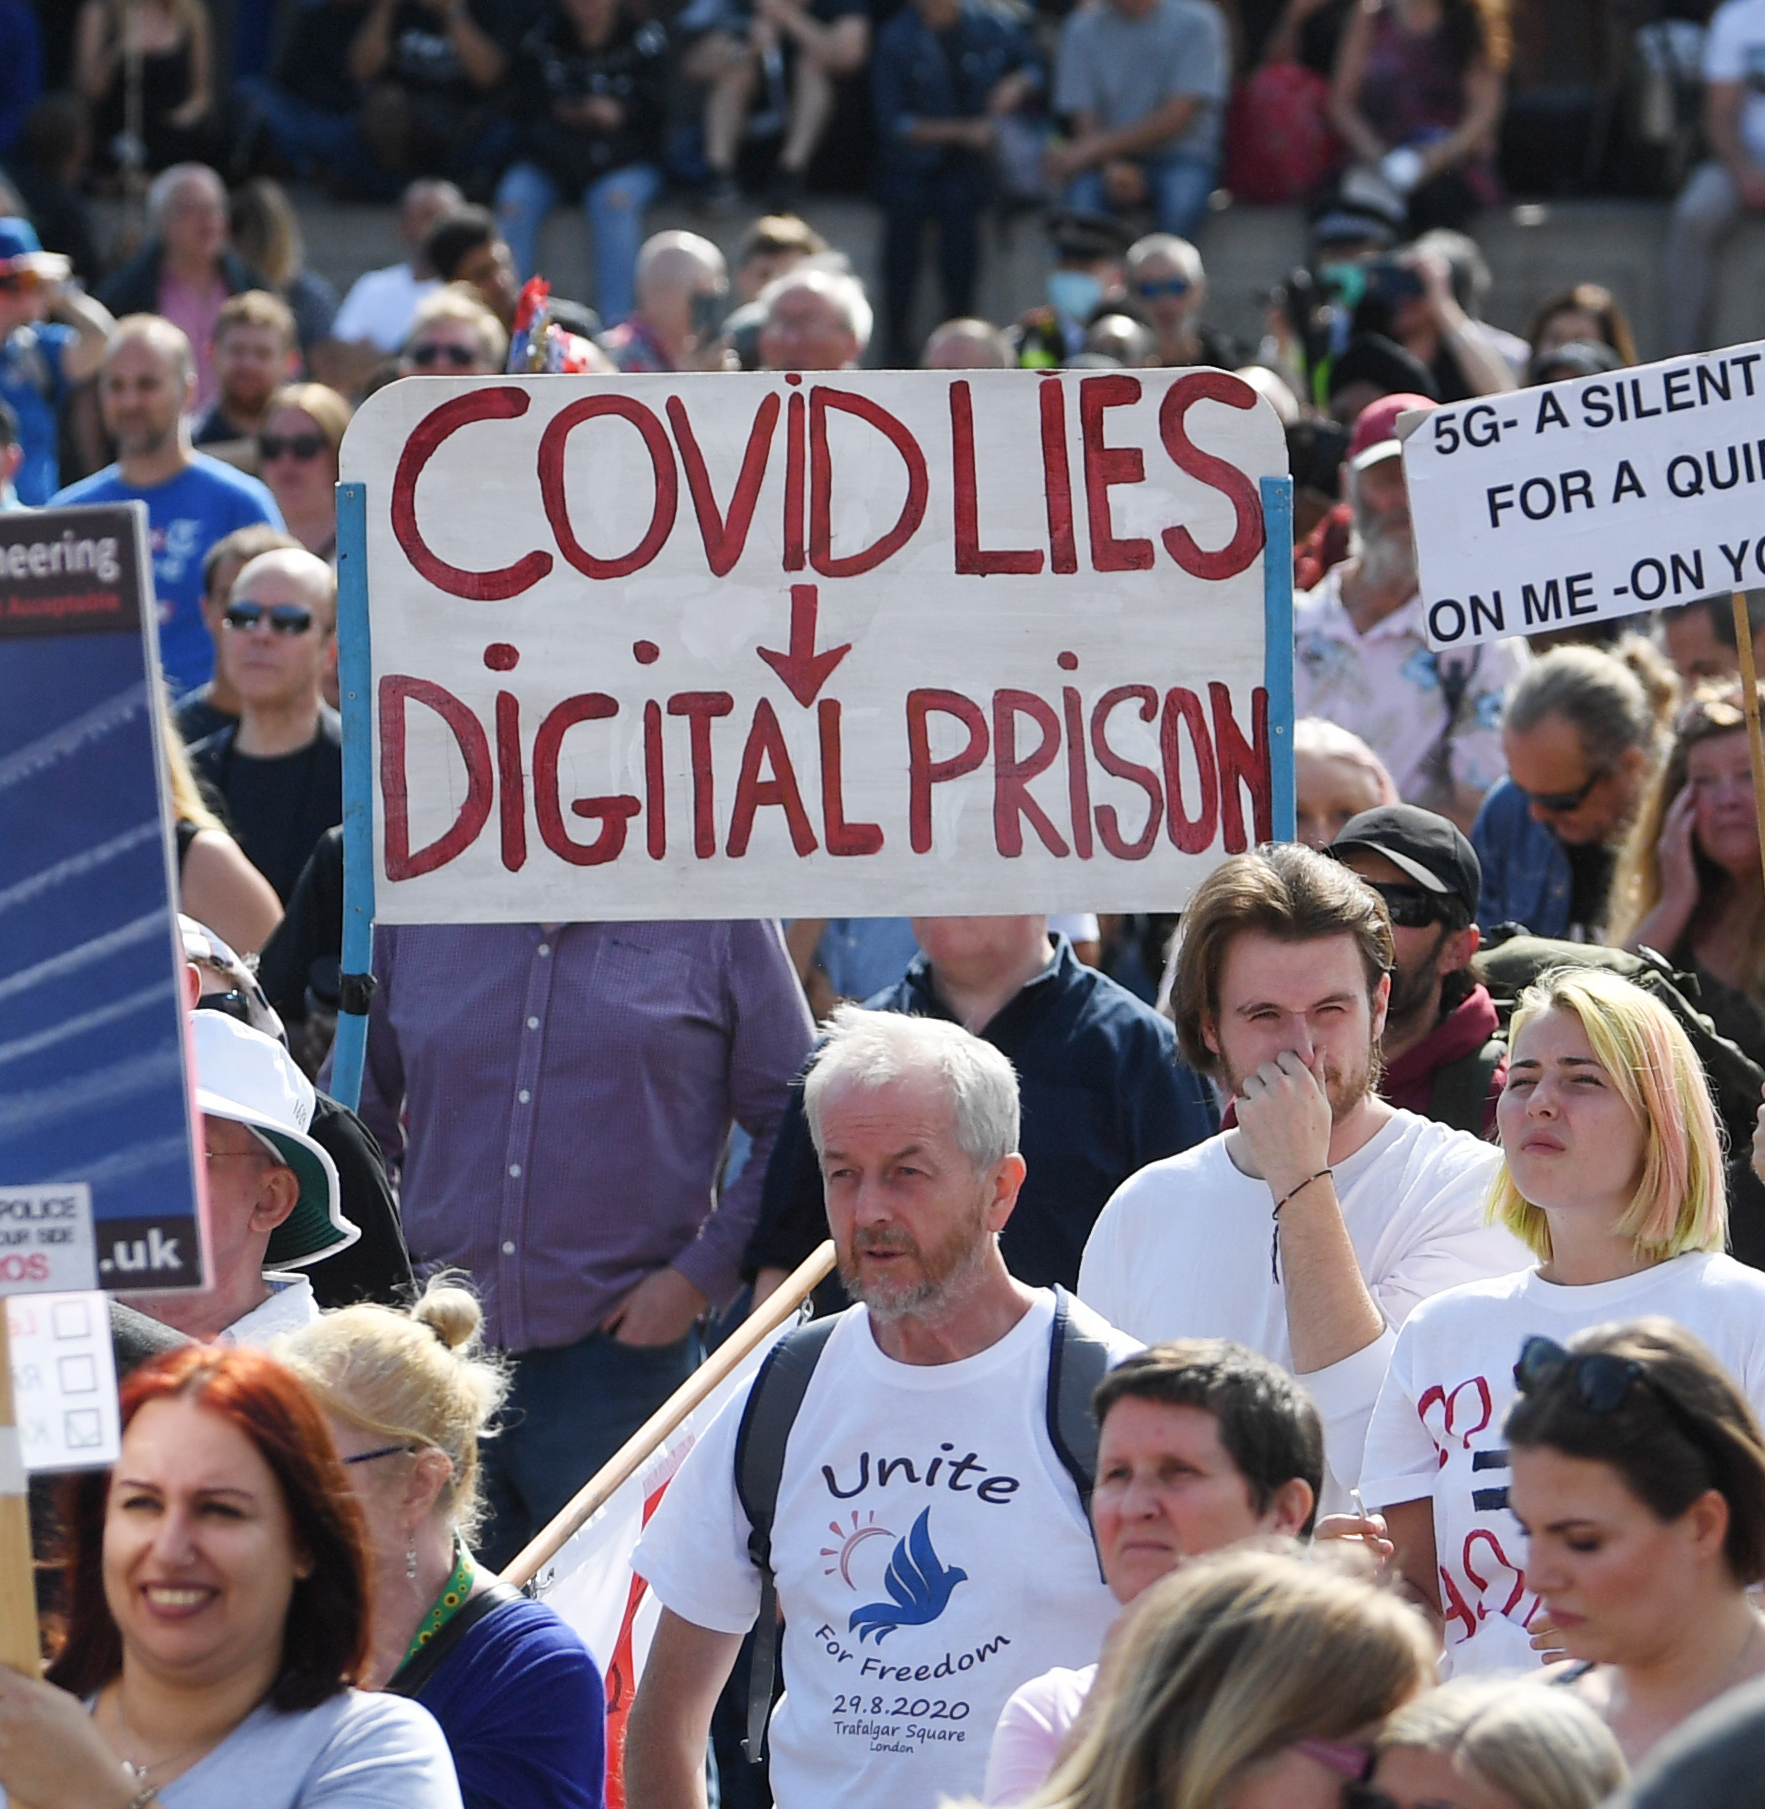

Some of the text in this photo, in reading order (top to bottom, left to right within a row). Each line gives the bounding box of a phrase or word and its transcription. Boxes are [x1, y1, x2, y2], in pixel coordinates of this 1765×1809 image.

[1534, 391, 1571, 435] A
[1582, 352, 1764, 429] SILENT
[391, 373, 930, 601] COVID
[950, 370, 1267, 581] LIES
[1486, 468, 1596, 529] FOR
[1611, 459, 1647, 504] A
[1427, 590, 1506, 643] ON
[1521, 571, 1600, 626] ME
[378, 639, 1272, 883] DIGITAL PRISON
[37, 1224, 75, 1246] SIDE
[99, 1227, 183, 1272] .uk
[821, 1442, 1020, 1504] Unite
[815, 1623, 1012, 1682] For Freedom
[832, 1693, 971, 1721] 29.8.2020
[833, 1719, 967, 1744] Trafalgar Square
[869, 1740, 915, 1754] London
